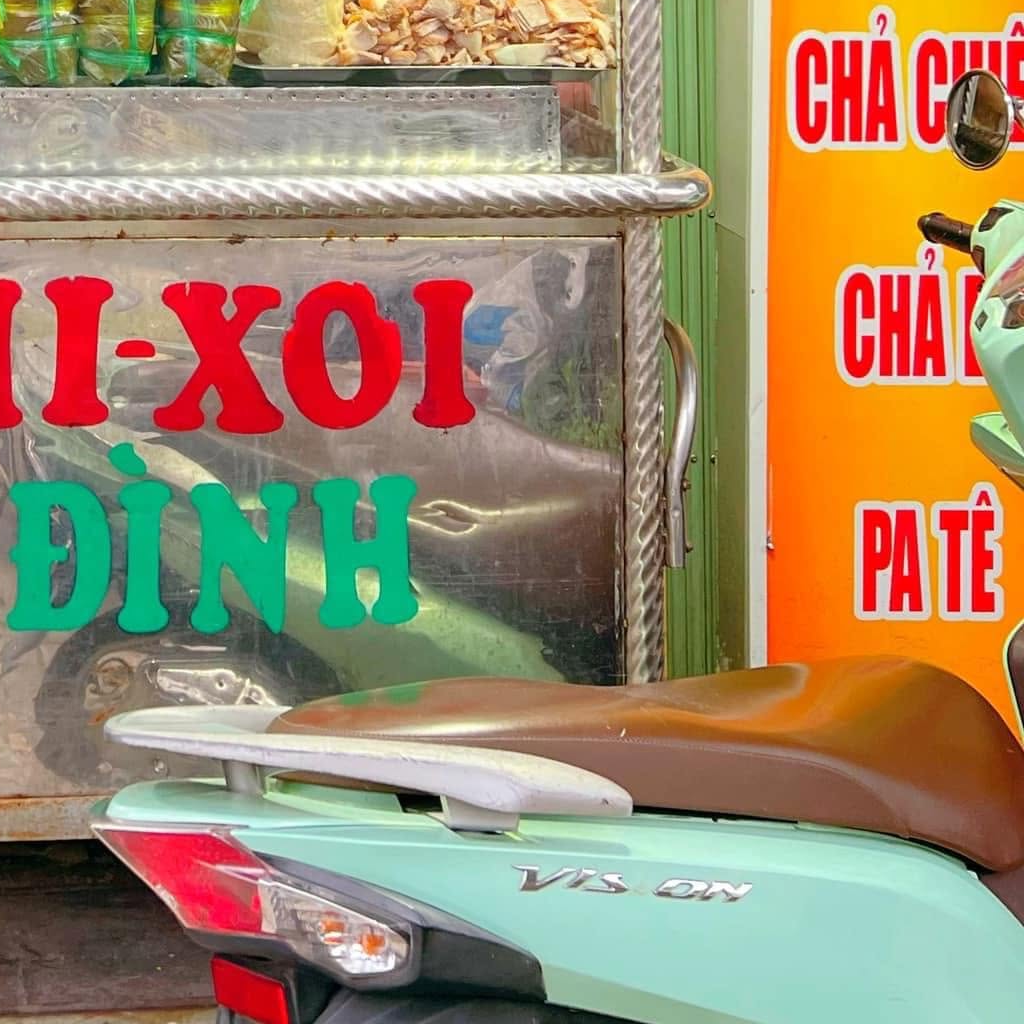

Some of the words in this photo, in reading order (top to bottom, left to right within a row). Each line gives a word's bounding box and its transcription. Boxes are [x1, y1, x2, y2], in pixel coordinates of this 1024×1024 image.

[793, 12, 898, 145] CHẢ
[842, 247, 946, 379] CHẢ
[7, 442, 419, 635] ĐÌNH
[862, 508, 924, 612] PA
[939, 489, 996, 613] TÊ
